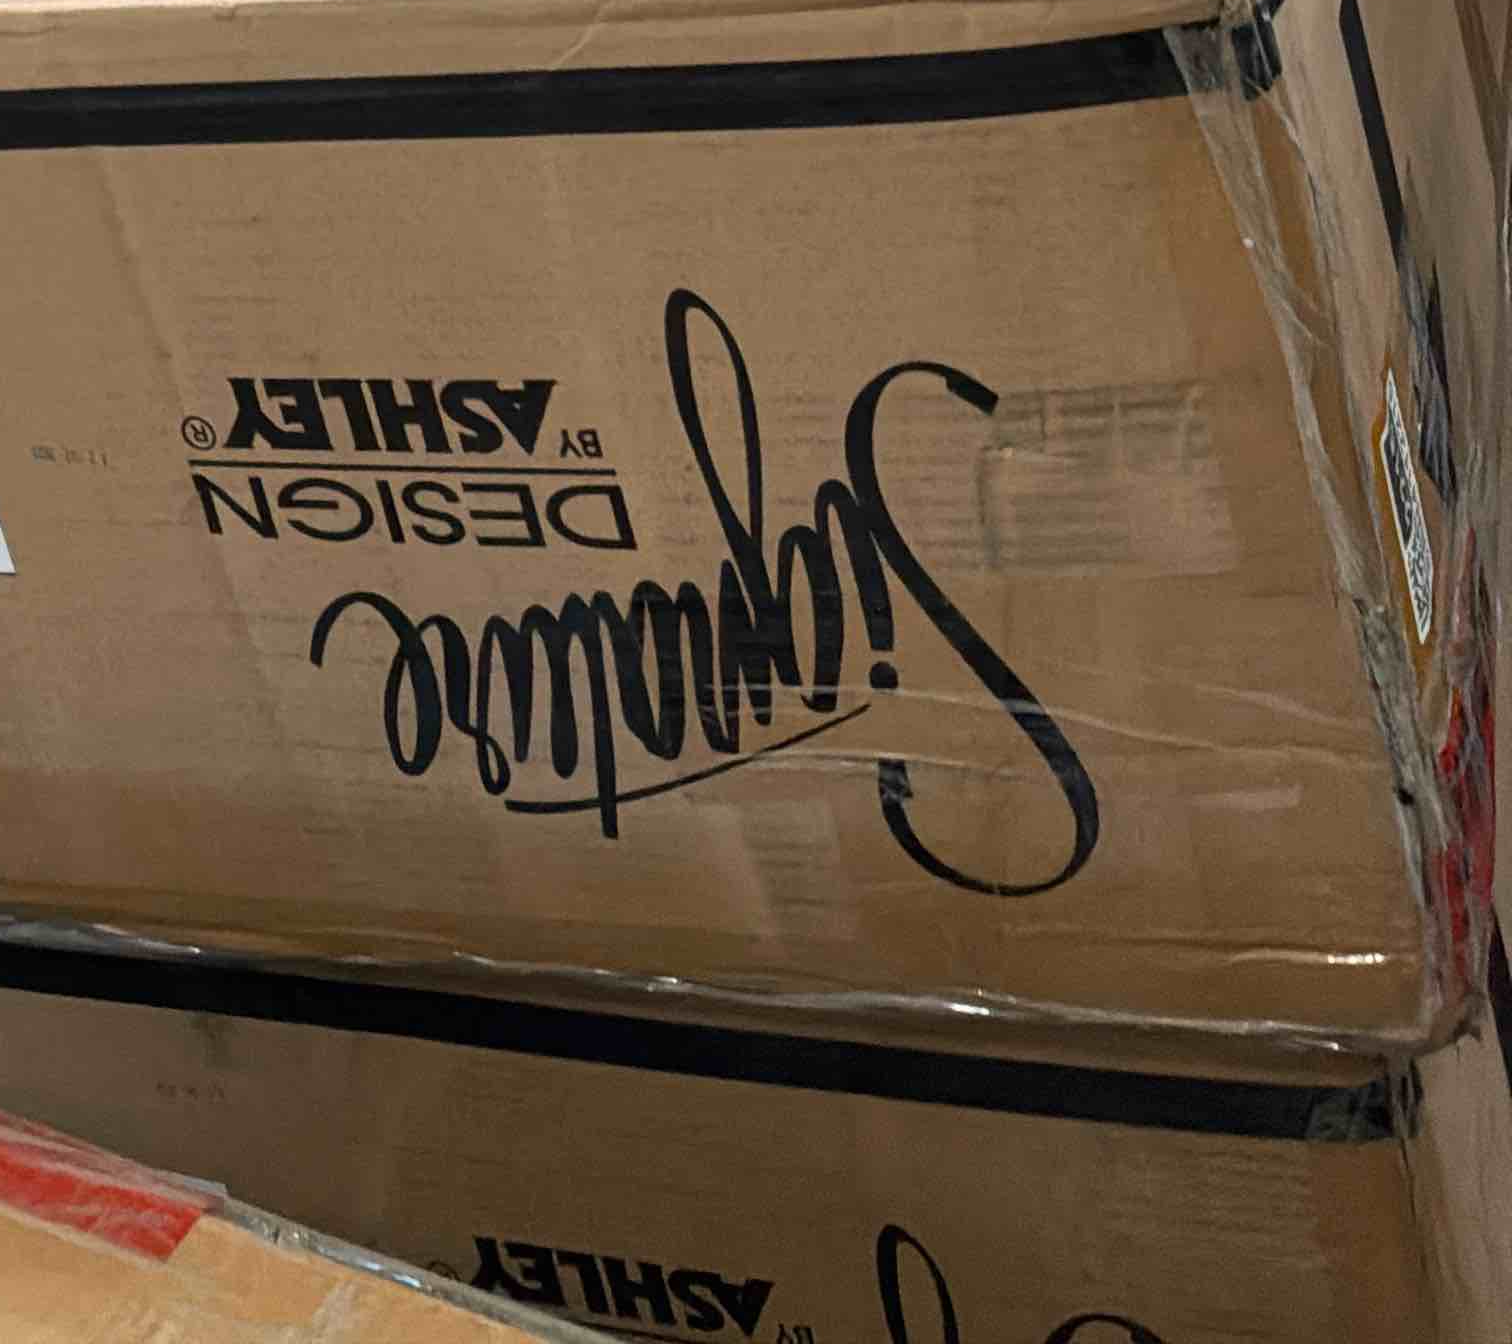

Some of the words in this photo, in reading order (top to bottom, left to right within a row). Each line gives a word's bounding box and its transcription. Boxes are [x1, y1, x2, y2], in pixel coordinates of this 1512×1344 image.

[223, 377, 556, 455] ASHLEY
[558, 428, 601, 459] BY
[191, 472, 638, 551] DESIGN
[310, 287, 1099, 897] Signature
[471, 1235, 775, 1339] ASHLEY
